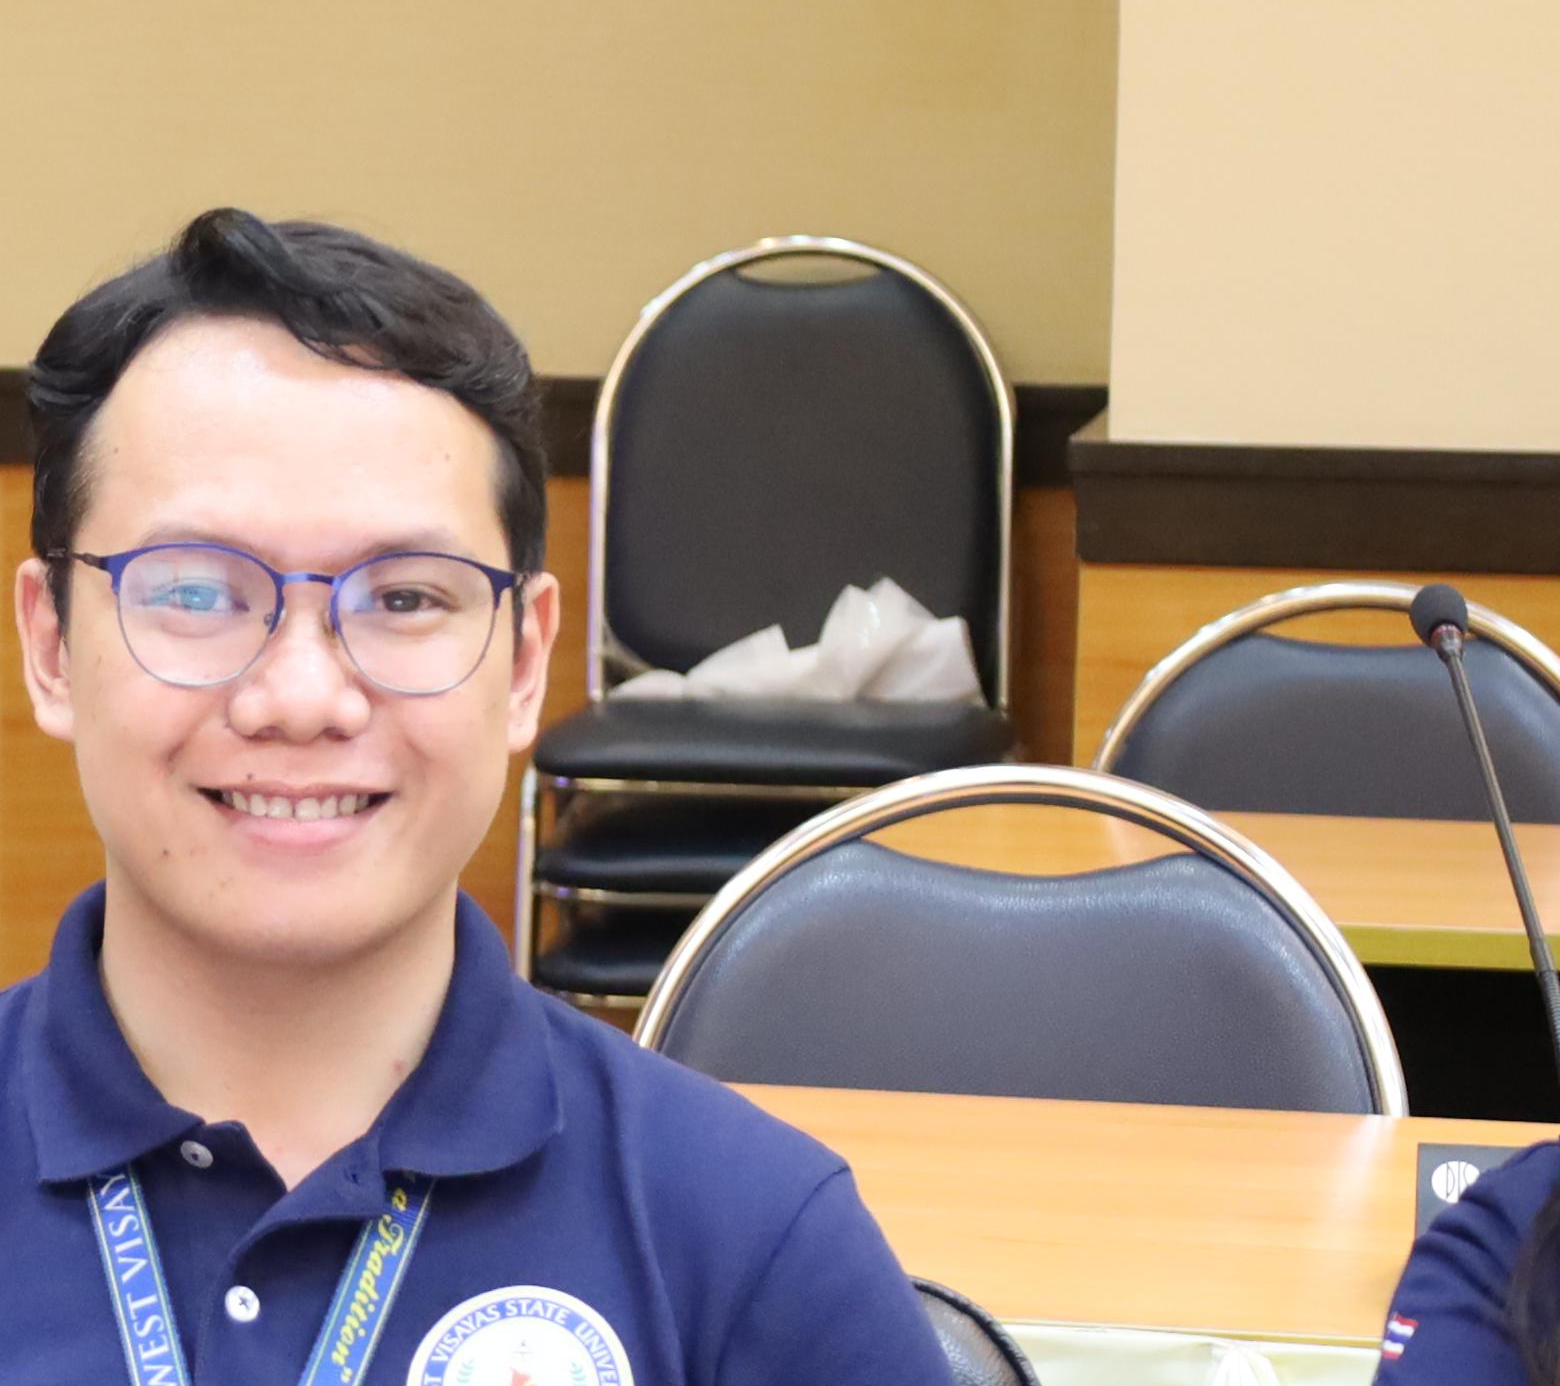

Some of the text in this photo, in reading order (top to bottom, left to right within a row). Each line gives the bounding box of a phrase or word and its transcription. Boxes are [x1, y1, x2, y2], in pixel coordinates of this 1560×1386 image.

[392, 1188, 407, 1211] a
[431, 1305, 501, 1363] VISAYAS
[505, 1300, 569, 1324] STATE
